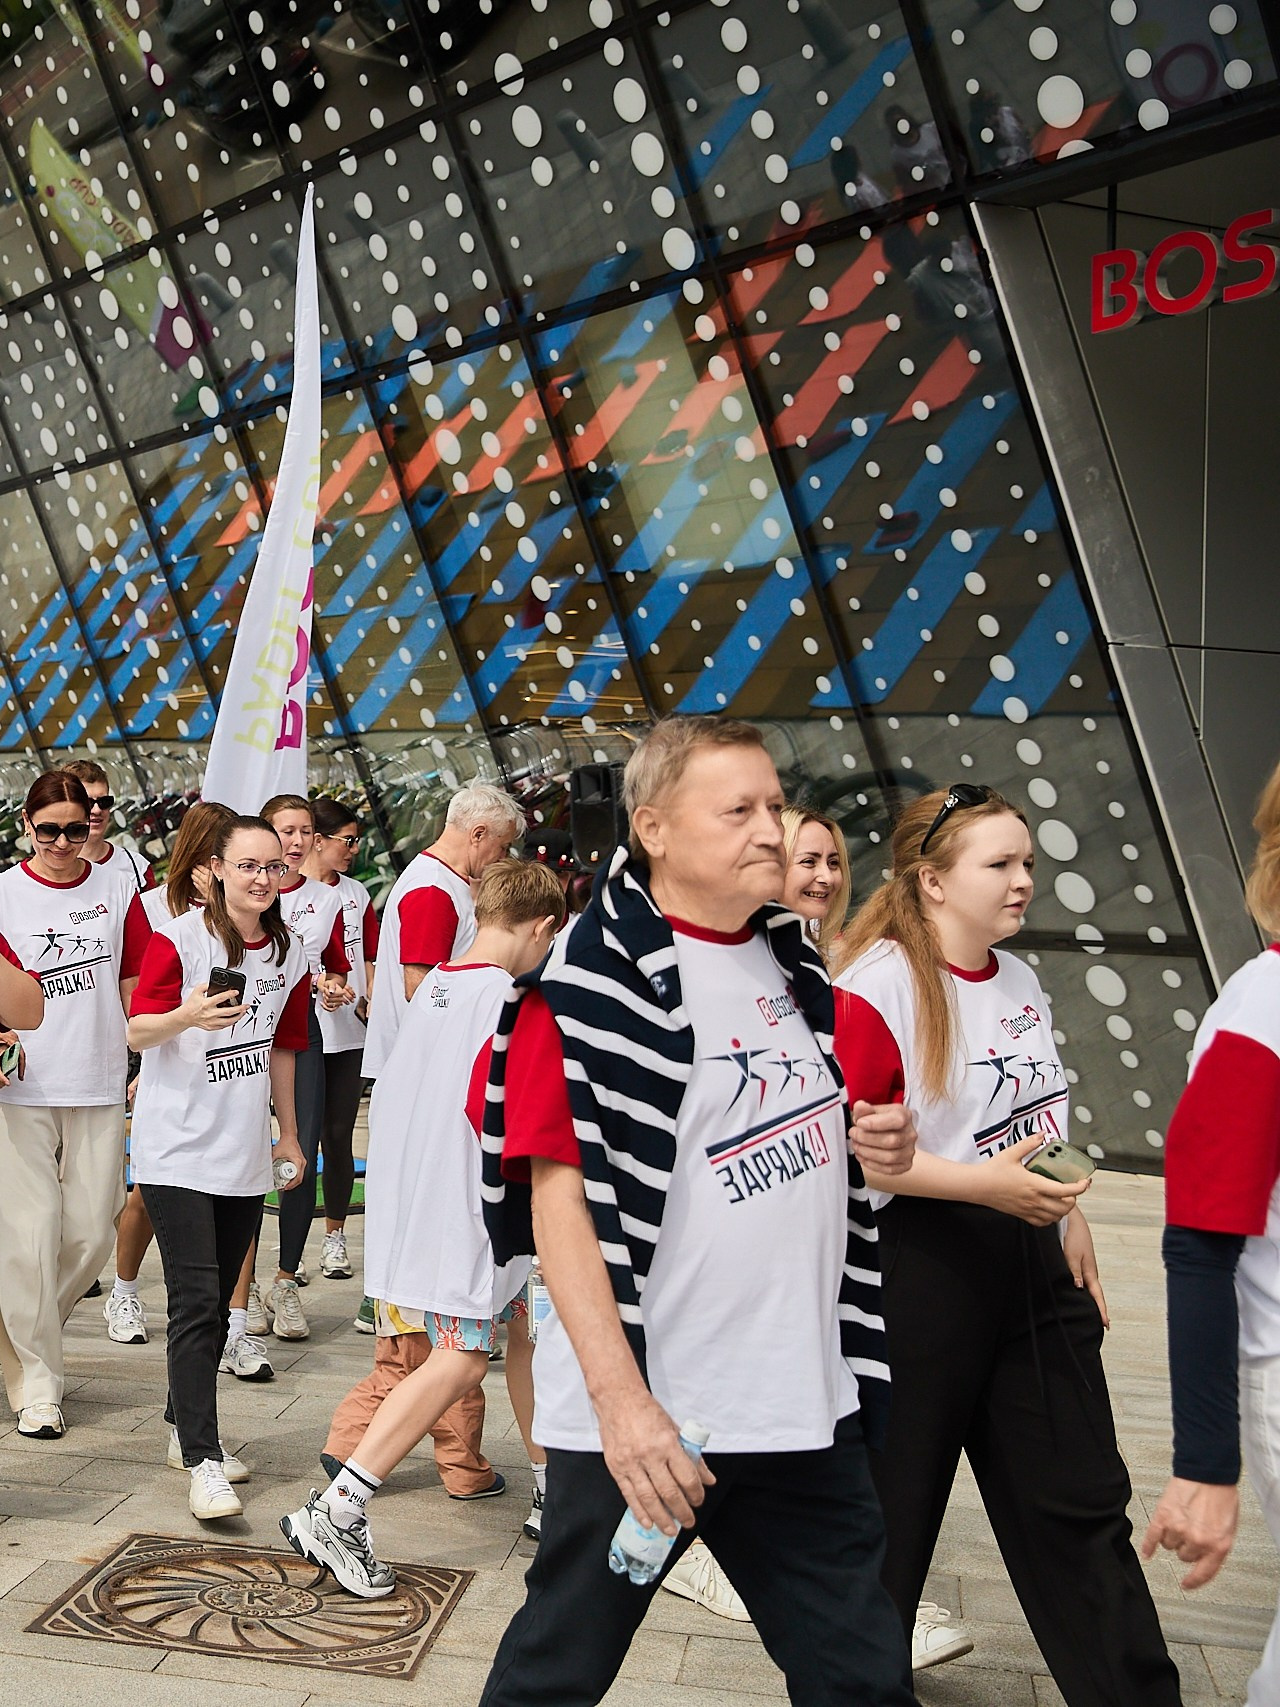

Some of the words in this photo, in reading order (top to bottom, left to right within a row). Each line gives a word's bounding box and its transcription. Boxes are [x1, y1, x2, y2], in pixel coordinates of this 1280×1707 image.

[1091, 208, 1278, 334] BOS
[41, 969, 96, 999] АРЯДКА
[715, 1121, 830, 1204] ЗАРЯДКА
